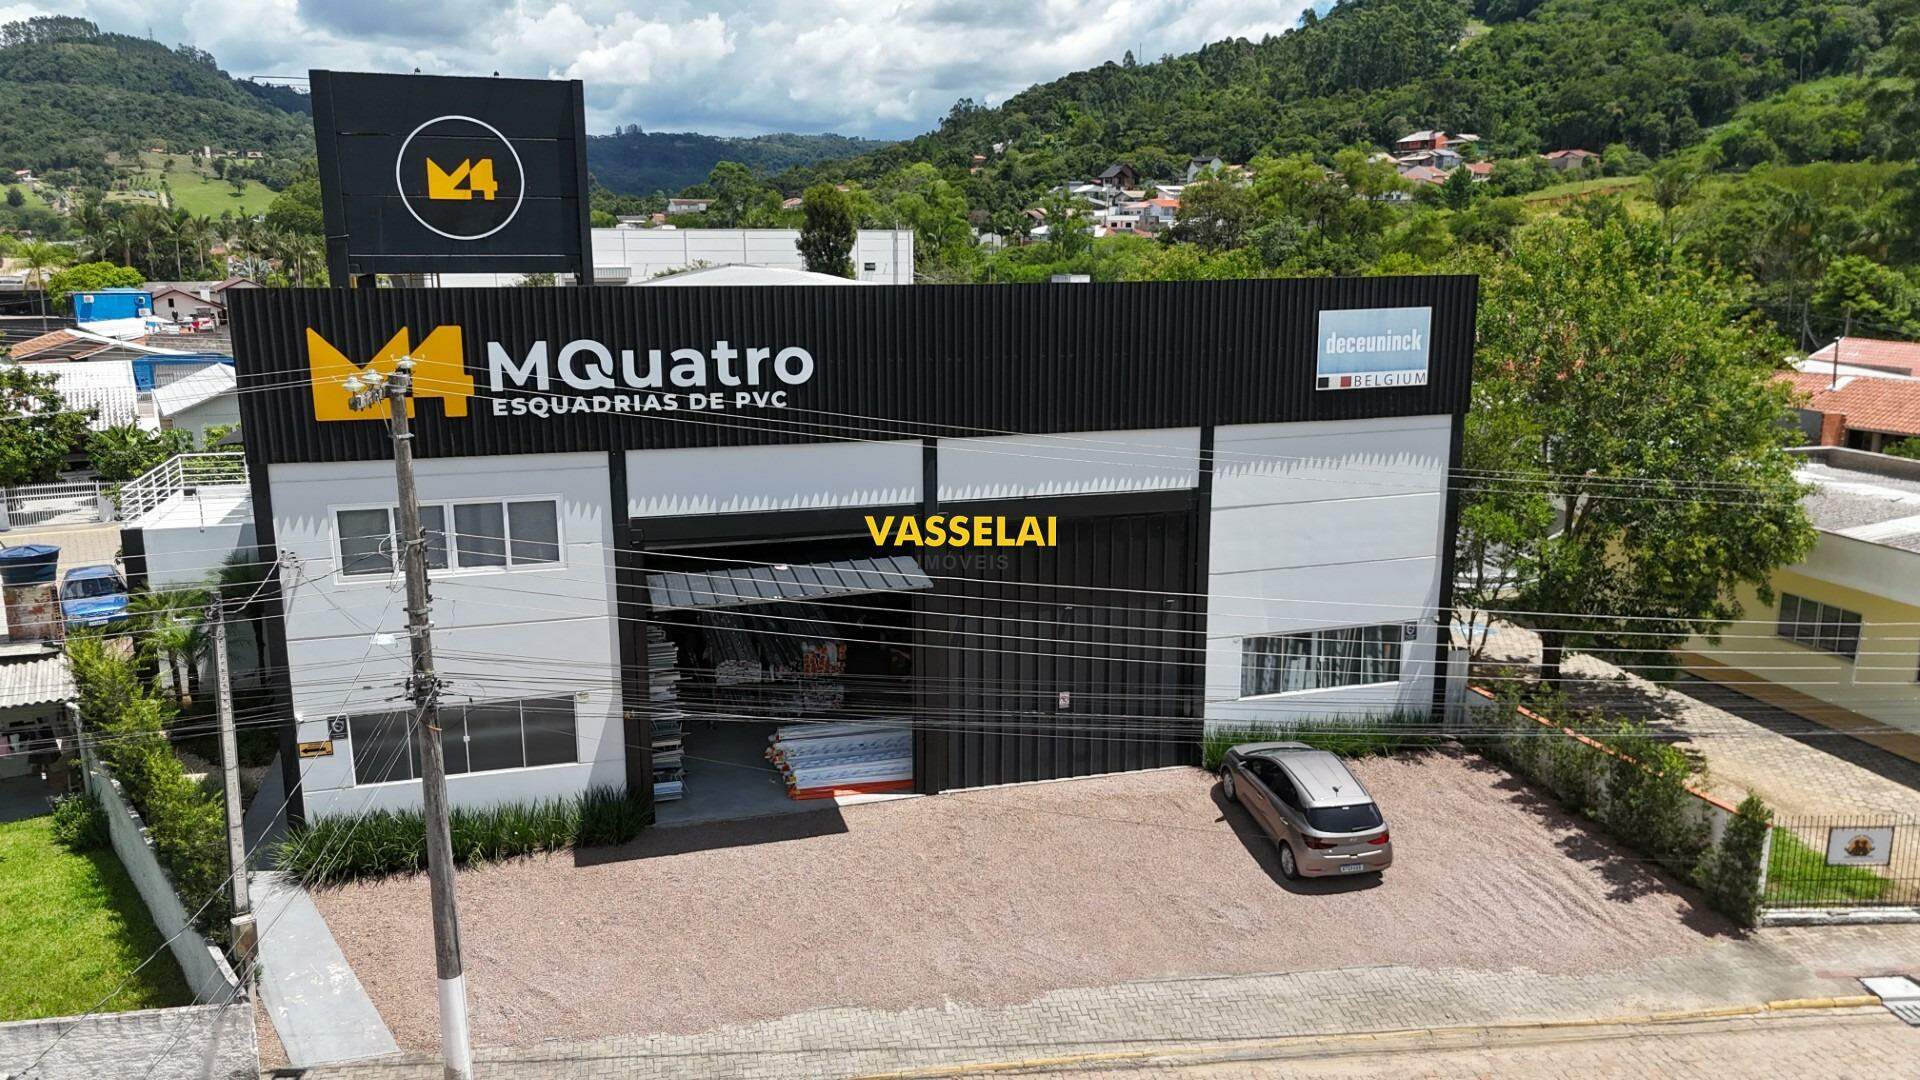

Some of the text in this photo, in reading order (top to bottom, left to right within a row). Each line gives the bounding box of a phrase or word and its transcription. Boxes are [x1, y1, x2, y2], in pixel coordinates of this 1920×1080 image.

[1325, 329, 1423, 354] deceuninck
[487, 339, 815, 392] MQuatro
[1354, 373, 1426, 387] BELGIUM
[492, 390, 788, 419] ESQUADRIAS DE PVC
